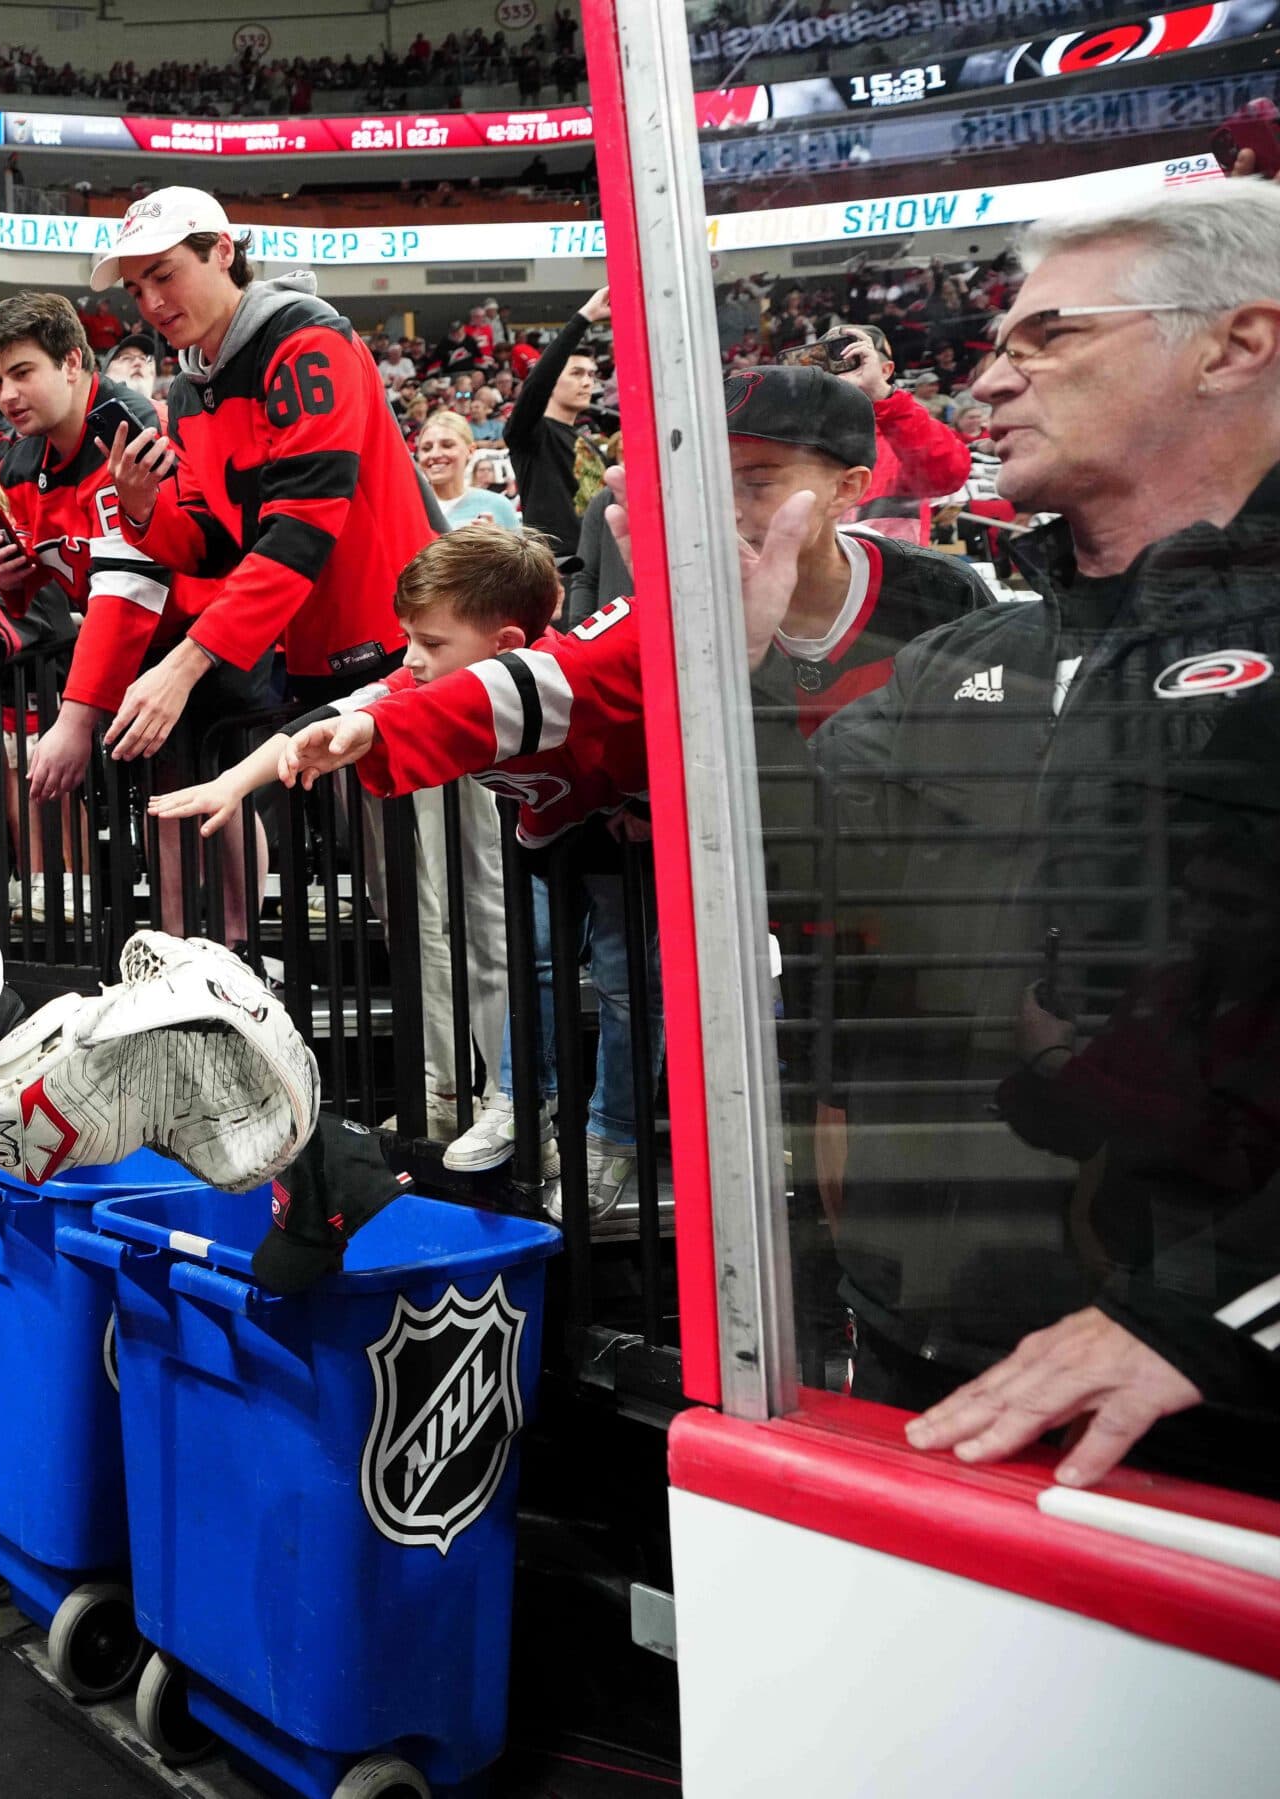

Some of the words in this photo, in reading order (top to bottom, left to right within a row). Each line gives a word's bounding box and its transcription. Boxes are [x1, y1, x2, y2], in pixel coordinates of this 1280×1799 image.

[501, 4, 532, 20] 333
[850, 64, 946, 101] 15:31
[1164, 158, 1208, 176] 99.9
[843, 195, 960, 234] SHOW
[312, 231, 359, 259] 12P
[381, 231, 419, 258] 3P
[549, 225, 607, 253] THE
[266, 351, 335, 430] 86
[404, 1348, 496, 1504] NHL
